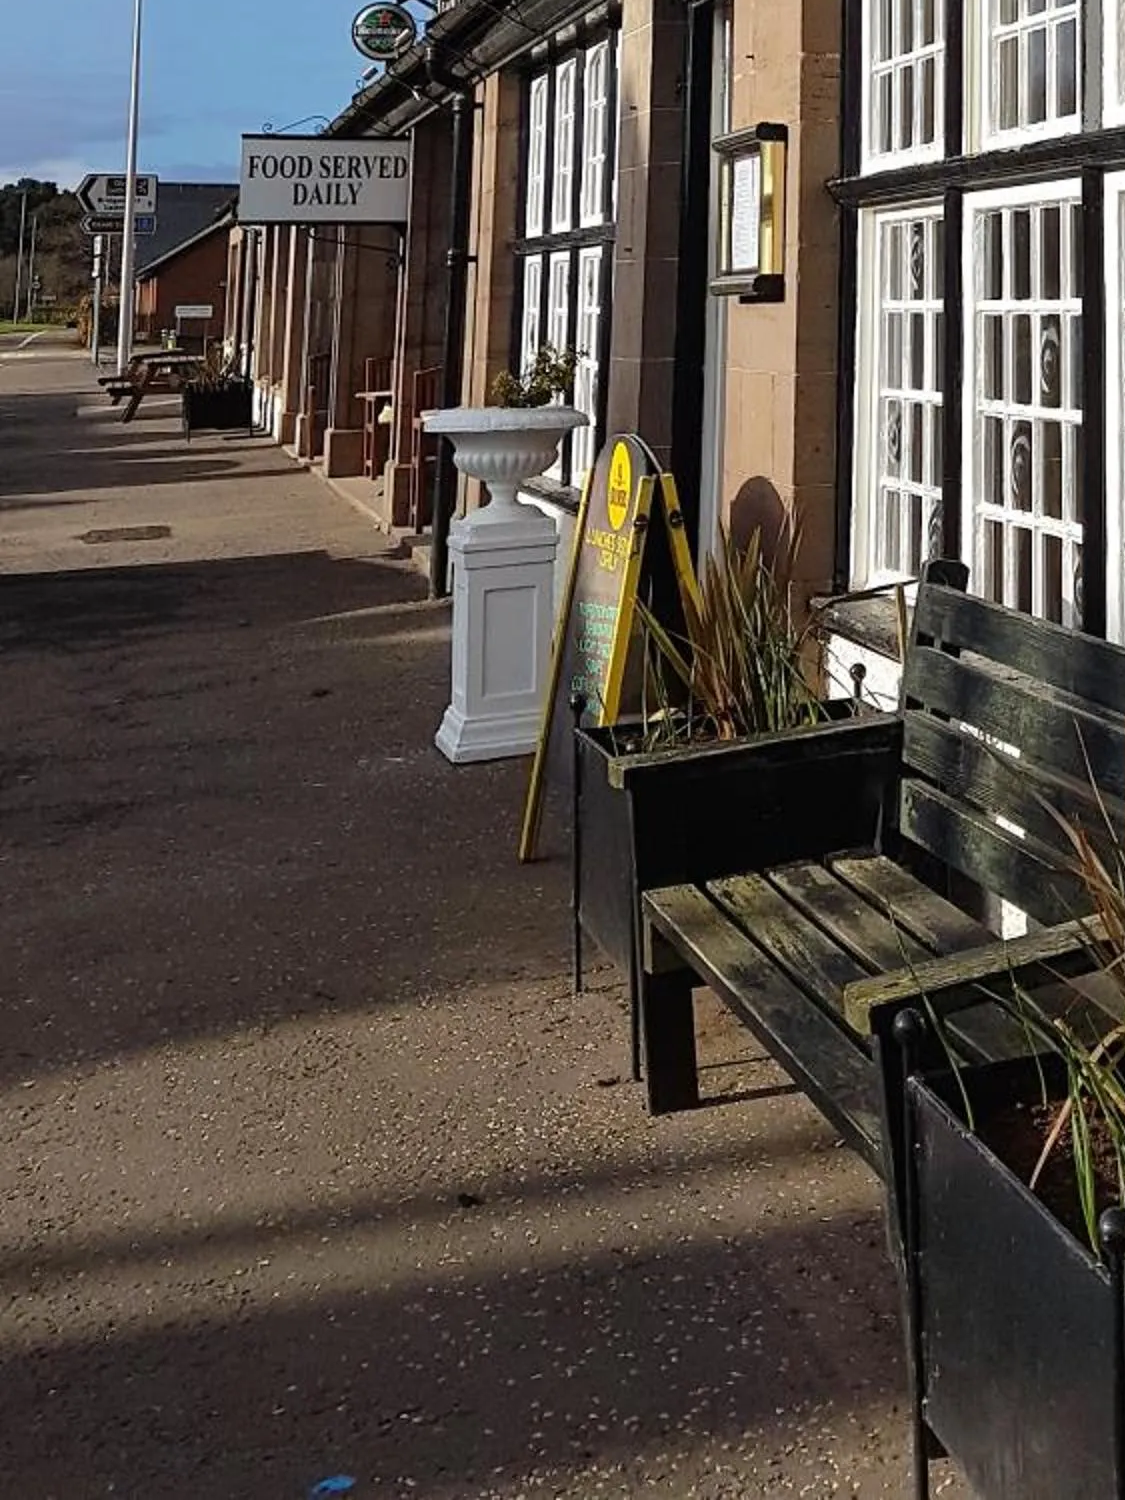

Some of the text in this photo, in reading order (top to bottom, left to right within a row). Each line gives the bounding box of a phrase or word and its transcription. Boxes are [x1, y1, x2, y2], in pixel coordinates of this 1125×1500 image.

[248, 155, 408, 179] FOOD SERVED
[292, 182, 363, 206] DAILY
